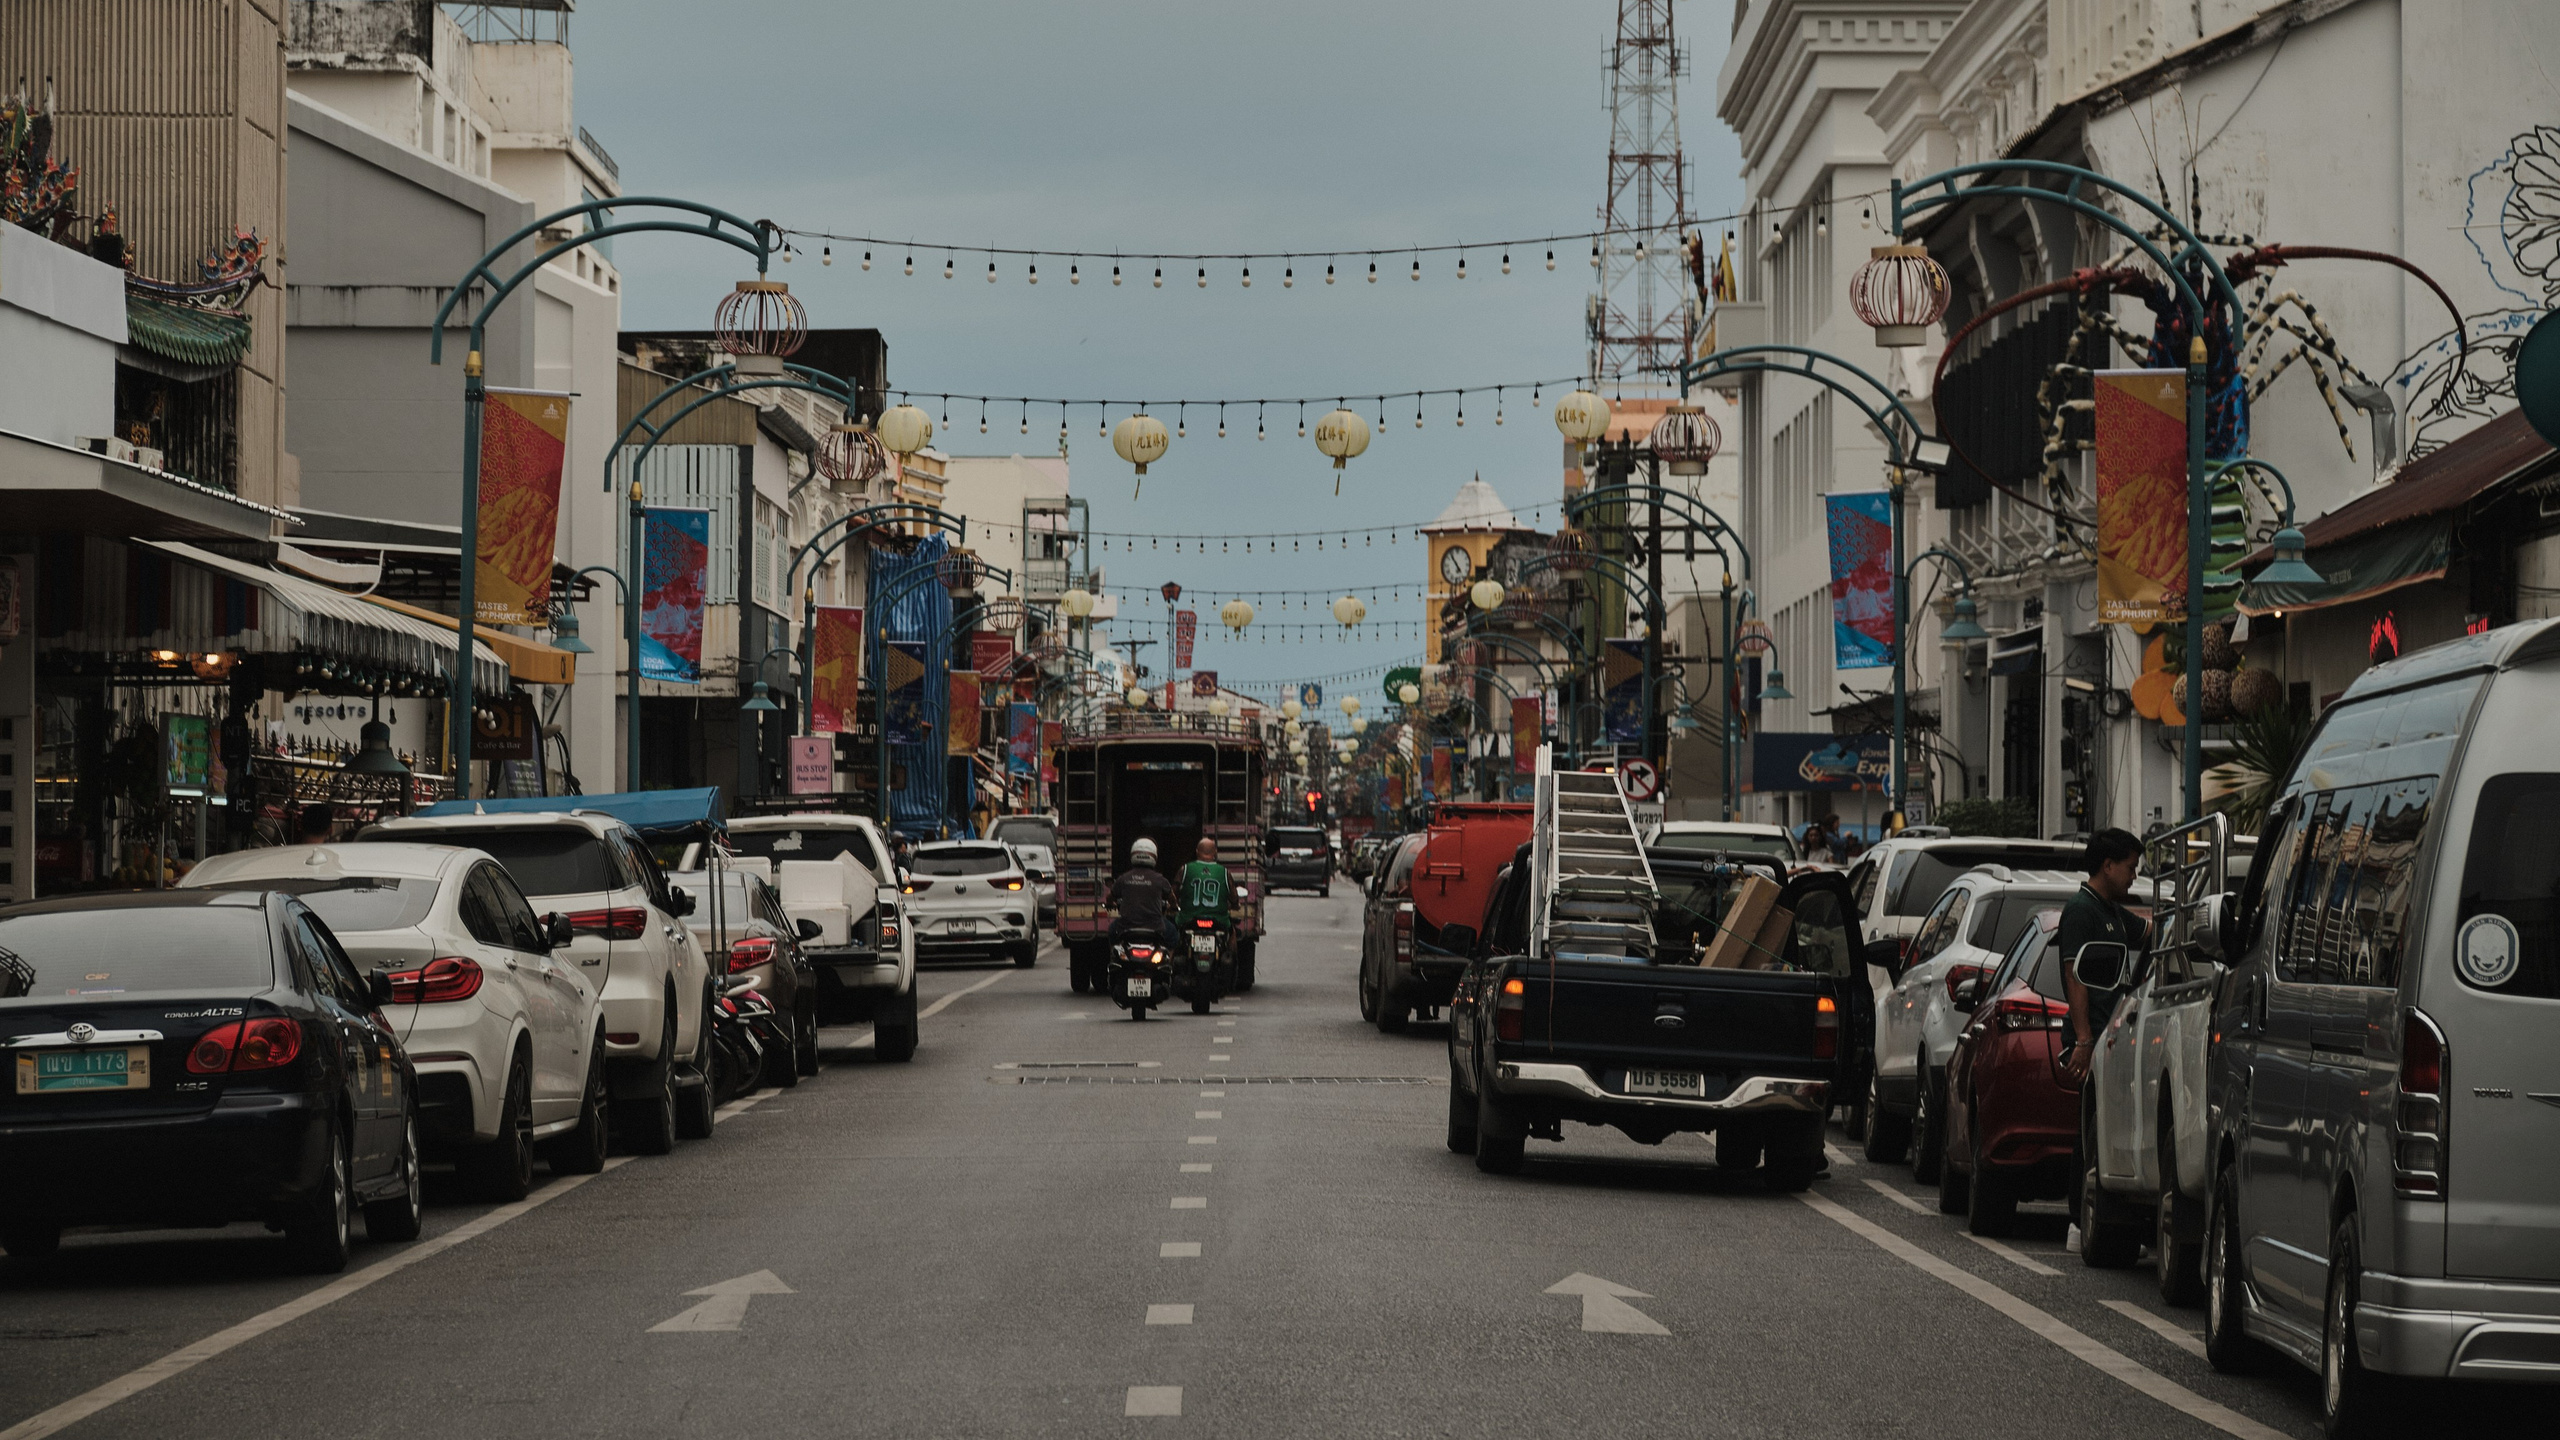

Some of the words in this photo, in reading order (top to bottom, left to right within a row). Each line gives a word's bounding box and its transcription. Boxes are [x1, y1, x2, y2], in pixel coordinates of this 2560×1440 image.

[476, 602, 508, 611] TASTES
[2106, 600, 2141, 609] TASTES
[475, 611, 487, 619] OF
[488, 611, 523, 621] PHUKET
[2106, 609, 2120, 619] OF
[2121, 609, 2159, 619] PHUKET
[477, 704, 522, 738] Qi
[498, 741, 505, 750] &
[506, 741, 522, 750] Bar
[810, 765, 828, 773] STOP
[1191, 878, 1221, 908] 19
[2487, 918, 2507, 929] KIDD
[164, 1011, 199, 1019] COROLLA
[200, 1007, 243, 1017] ALTIS
[84, 1053, 125, 1071] 1173
[1660, 1072, 1698, 1089] 5558
[2473, 1087, 2513, 1098] TOYOTA
